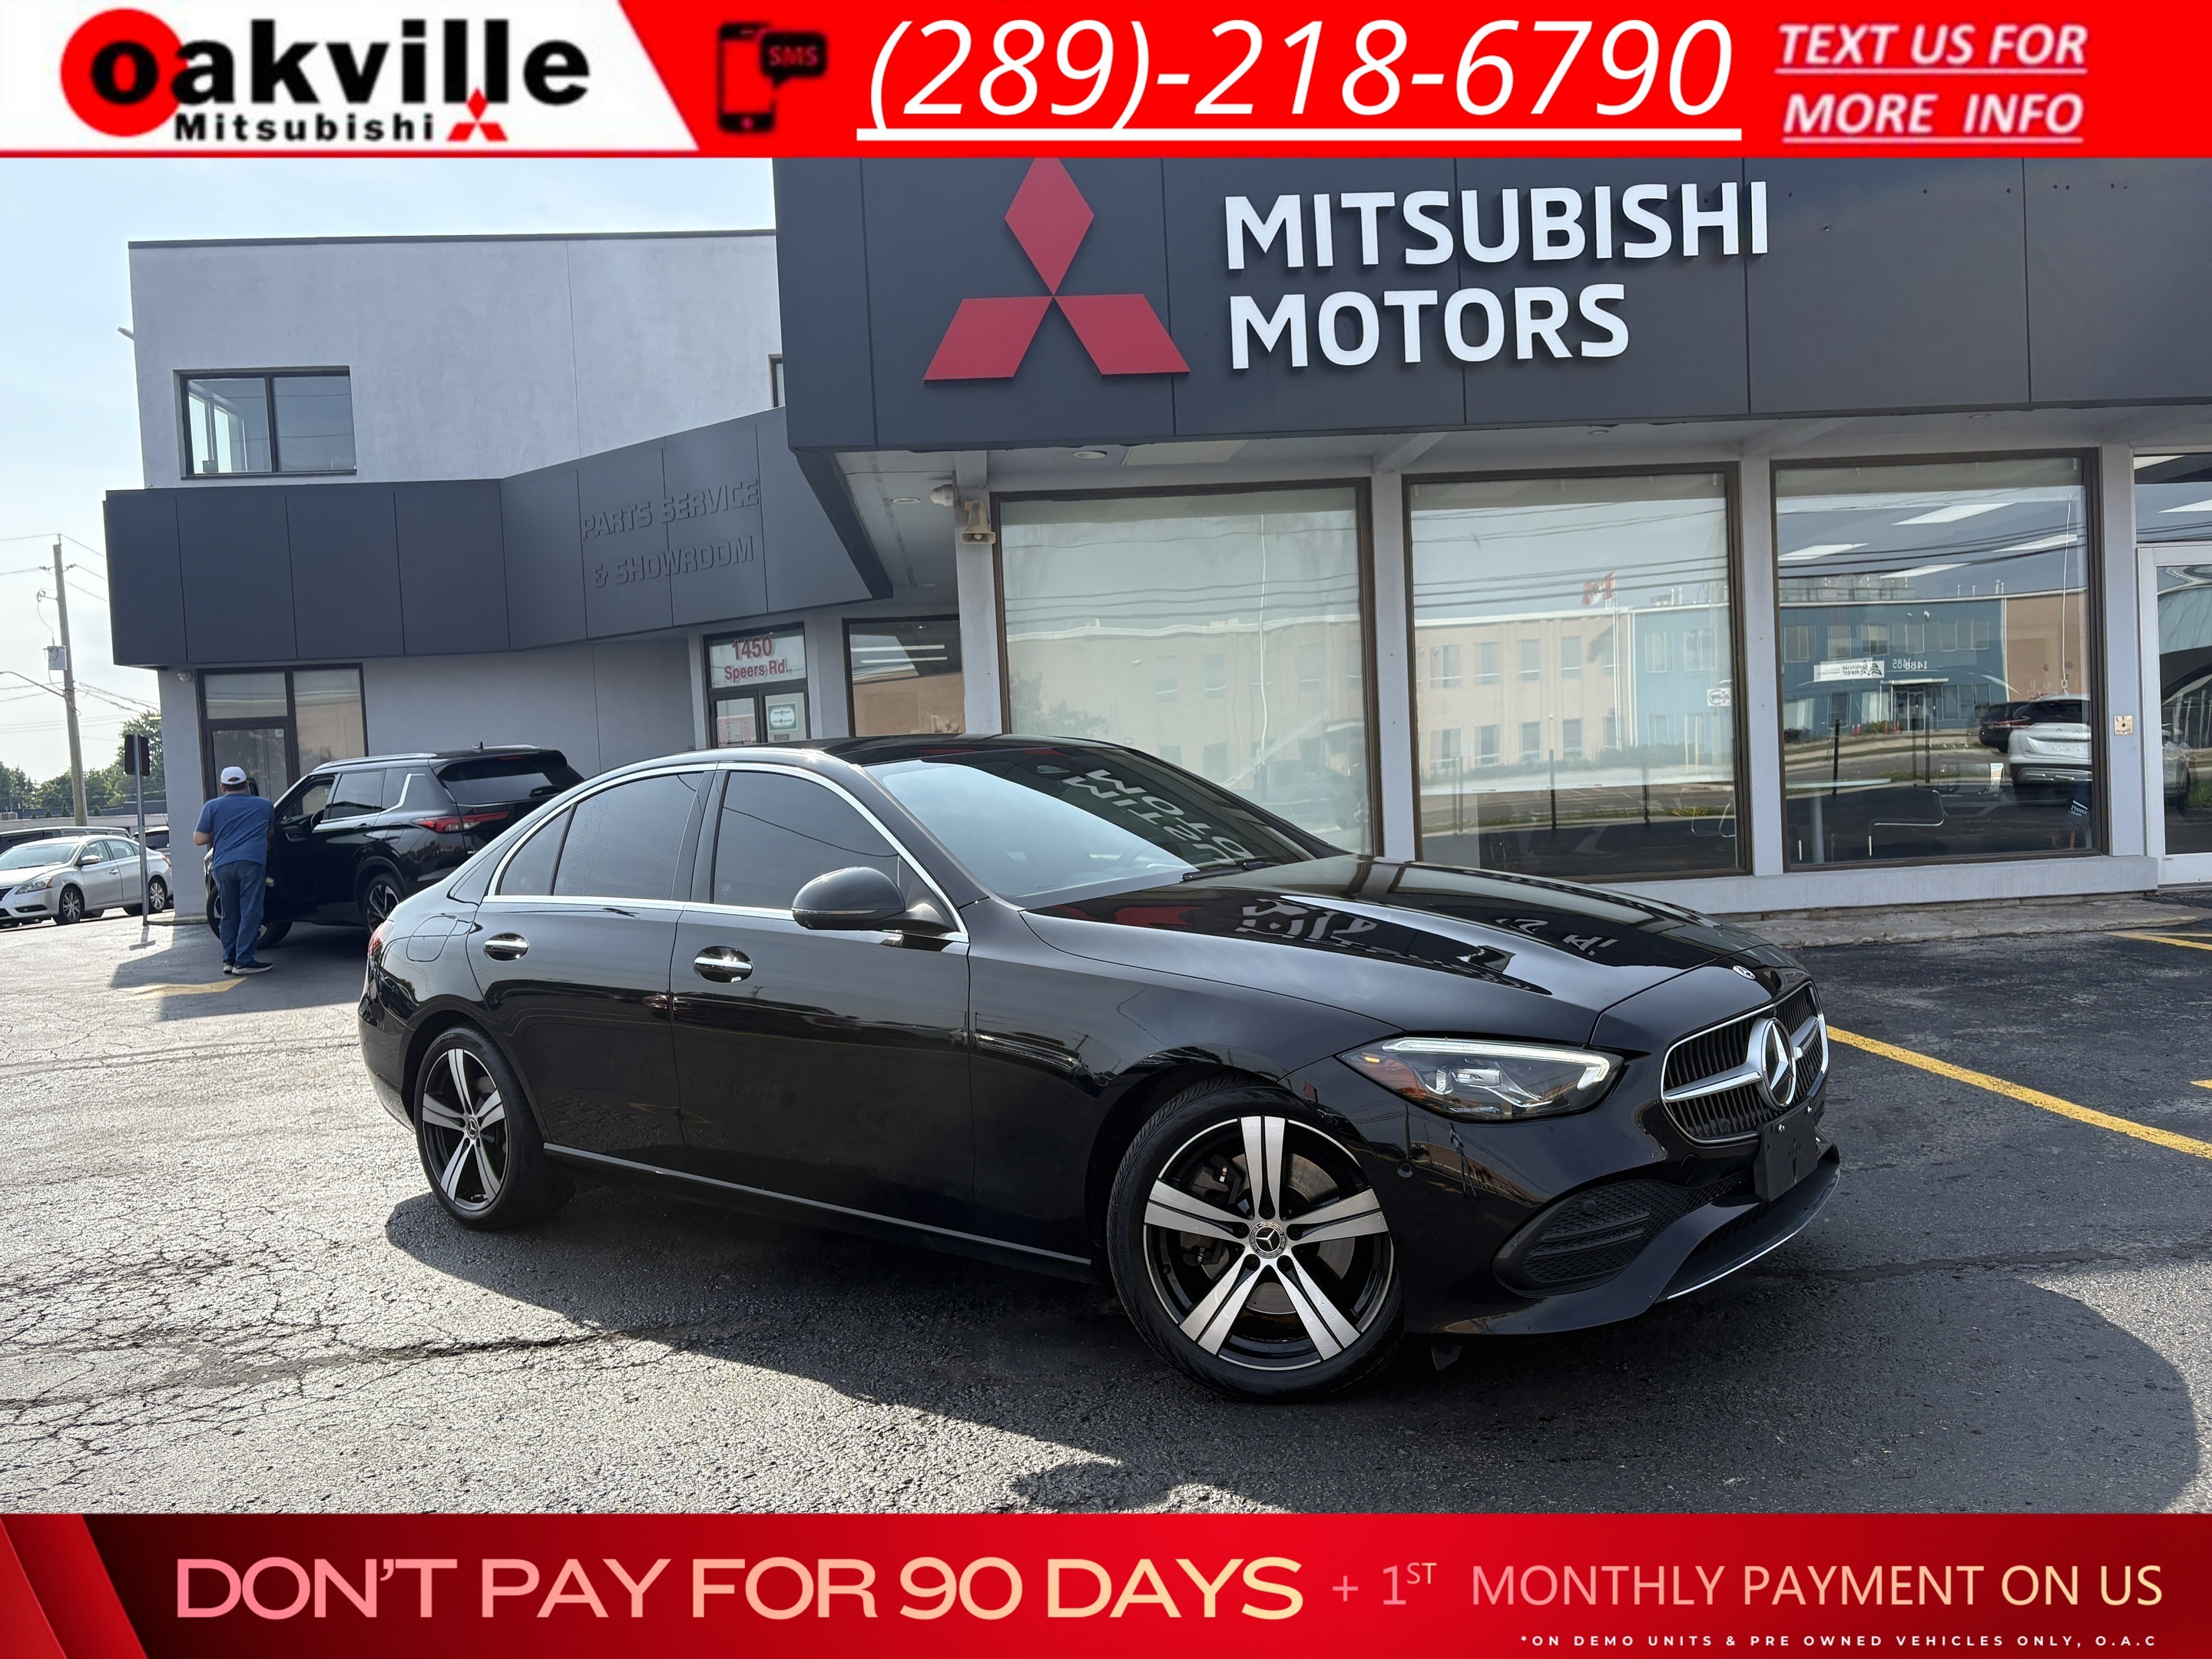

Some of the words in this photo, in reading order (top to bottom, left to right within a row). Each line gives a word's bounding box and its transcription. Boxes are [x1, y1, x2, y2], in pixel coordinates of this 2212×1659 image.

[1225, 181, 1768, 270] MITSUBISHI
[1230, 283, 1629, 369] MOTORS
[581, 501, 653, 540] PARTS
[661, 478, 760, 524] SERVICE
[594, 564, 608, 588] &
[615, 535, 754, 585] SHOWROOM
[724, 664, 766, 684] Speers
[731, 635, 773, 661] 1450
